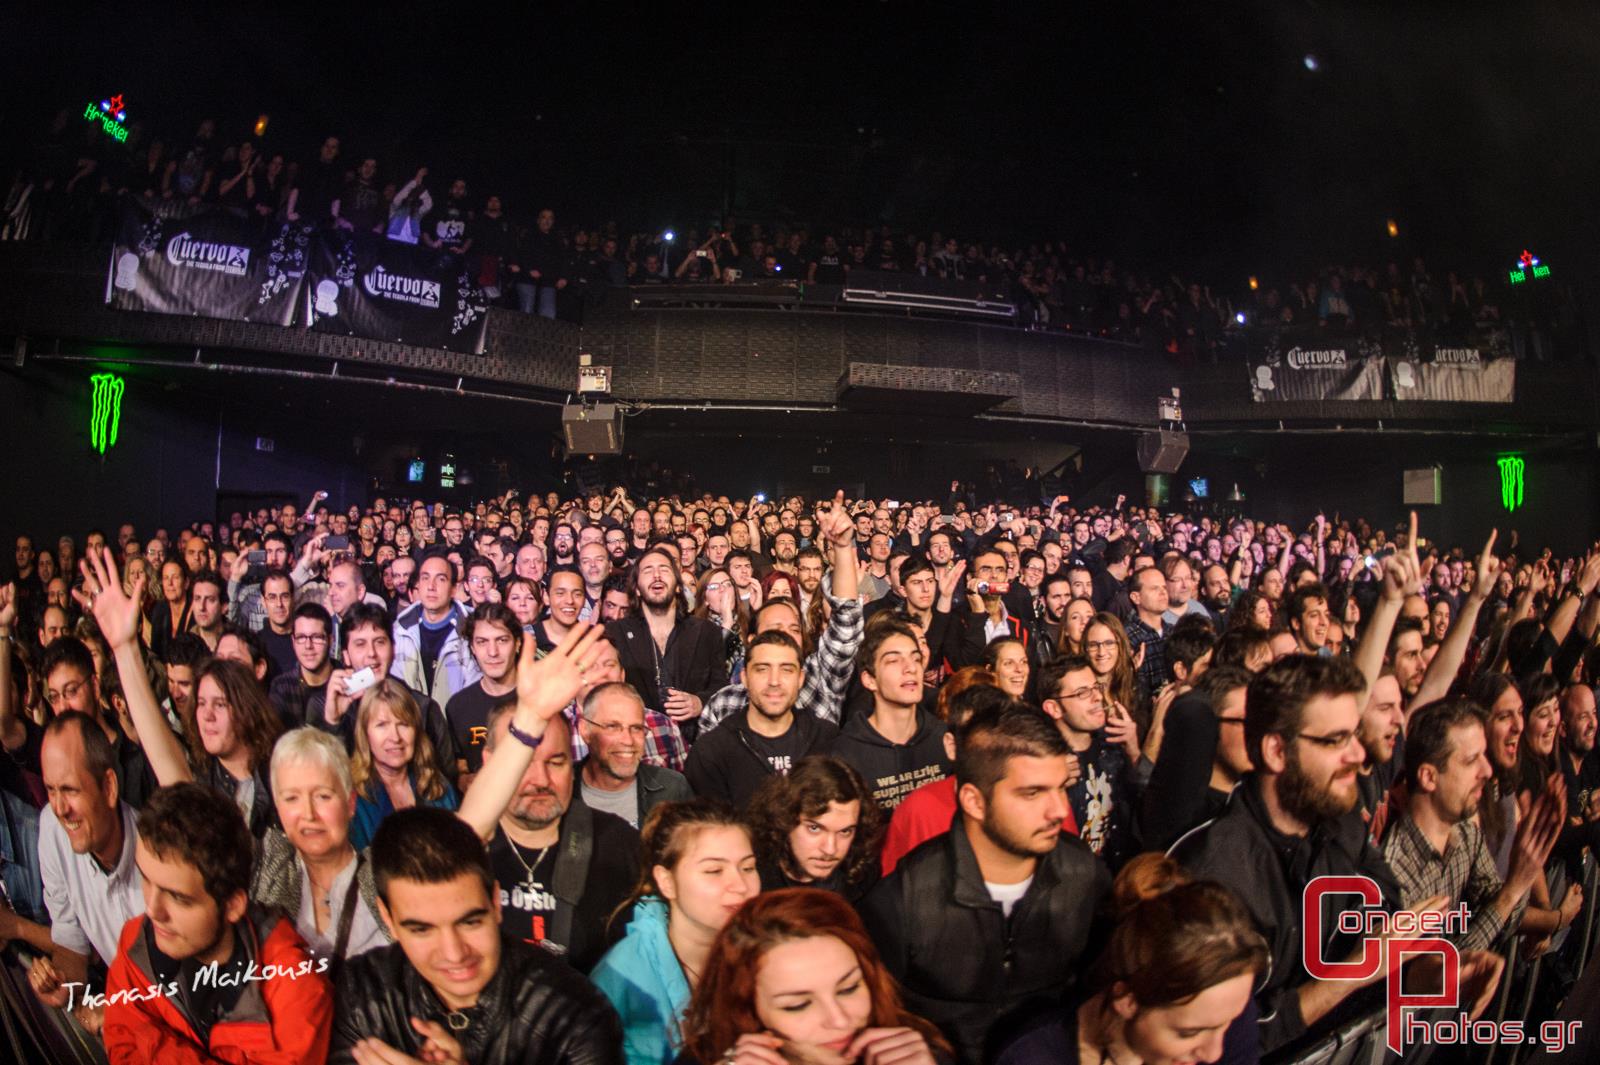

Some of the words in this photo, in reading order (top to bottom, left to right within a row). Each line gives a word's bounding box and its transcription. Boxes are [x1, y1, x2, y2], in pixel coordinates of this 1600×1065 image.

[167, 232, 228, 266] Cuervo
[364, 264, 421, 296] Cuervo
[1287, 346, 1331, 370] Cuervo
[1430, 346, 1466, 367] uervo
[767, 755, 792, 770] THE
